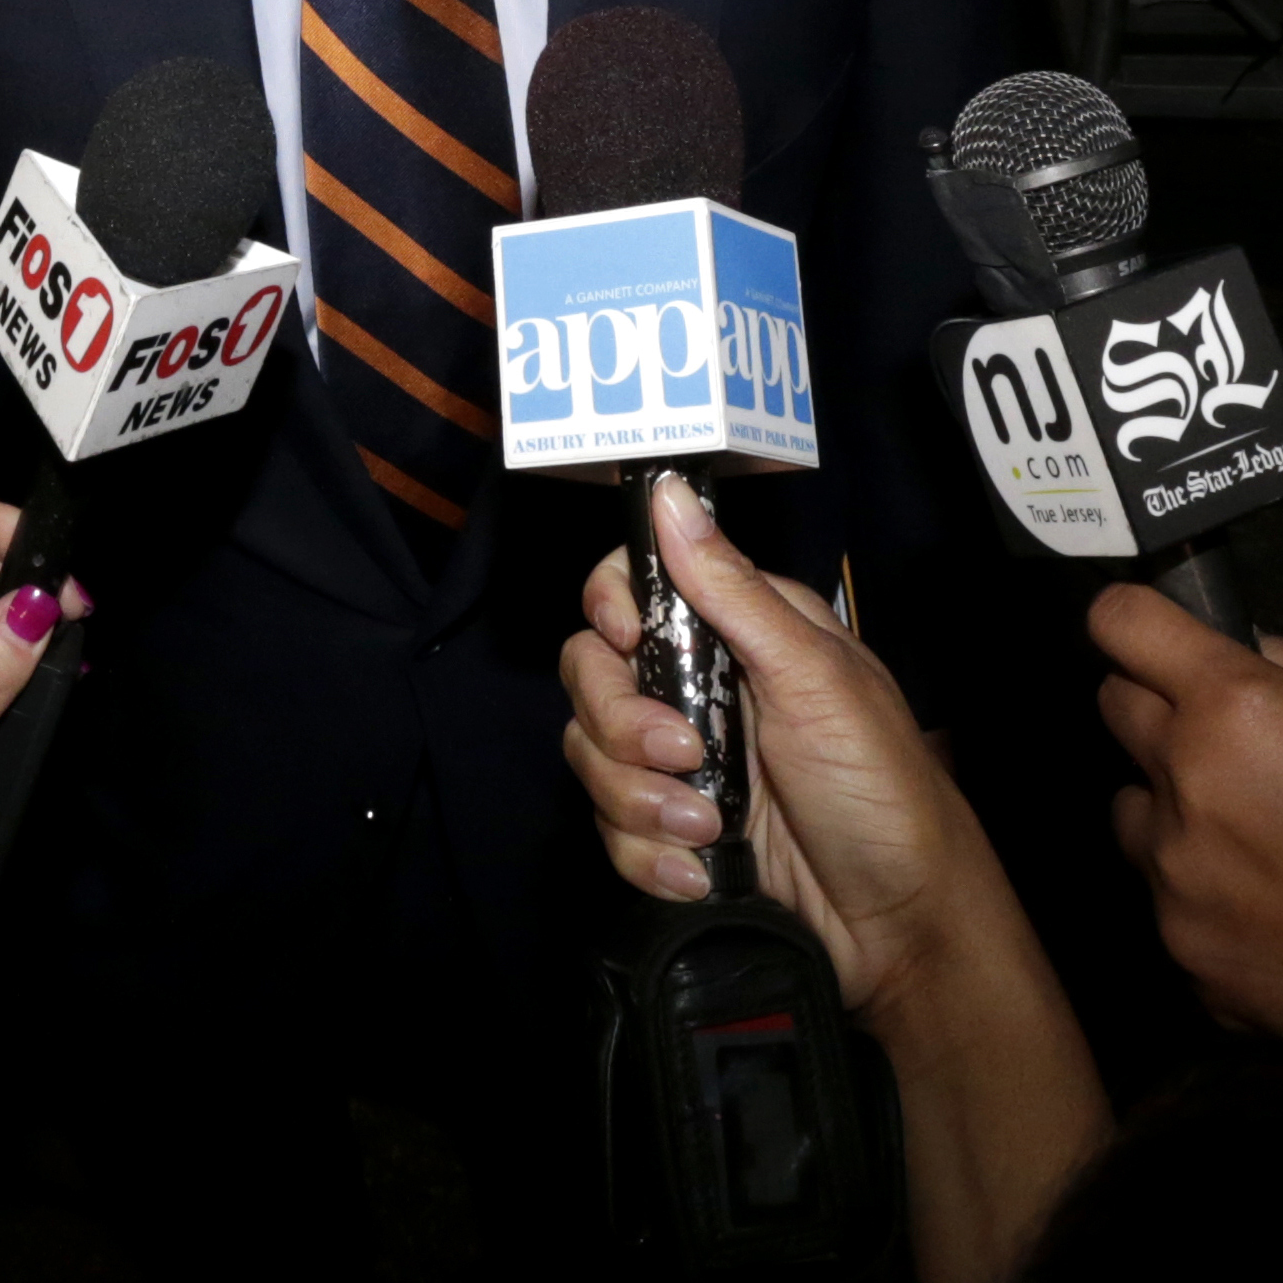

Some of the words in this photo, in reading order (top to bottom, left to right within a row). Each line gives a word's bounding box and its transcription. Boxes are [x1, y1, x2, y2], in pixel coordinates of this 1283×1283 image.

[564, 293, 573, 306] A
[576, 285, 633, 304] GANNETT
[636, 277, 699, 298] COMPANY
[504, 299, 714, 418] app
[718, 299, 812, 422] app
[118, 378, 220, 436] NEWS
[513, 432, 587, 455] ASBURY
[594, 429, 646, 448] PARK
[652, 422, 715, 442] PRESS
[728, 422, 763, 444] ASBURY
[765, 429, 789, 448] PARK
[789, 434, 816, 453] PRESS
[1027, 504, 1058, 525] True
[1061, 504, 1107, 528] Jersey.
[1143, 483, 1187, 517] The
